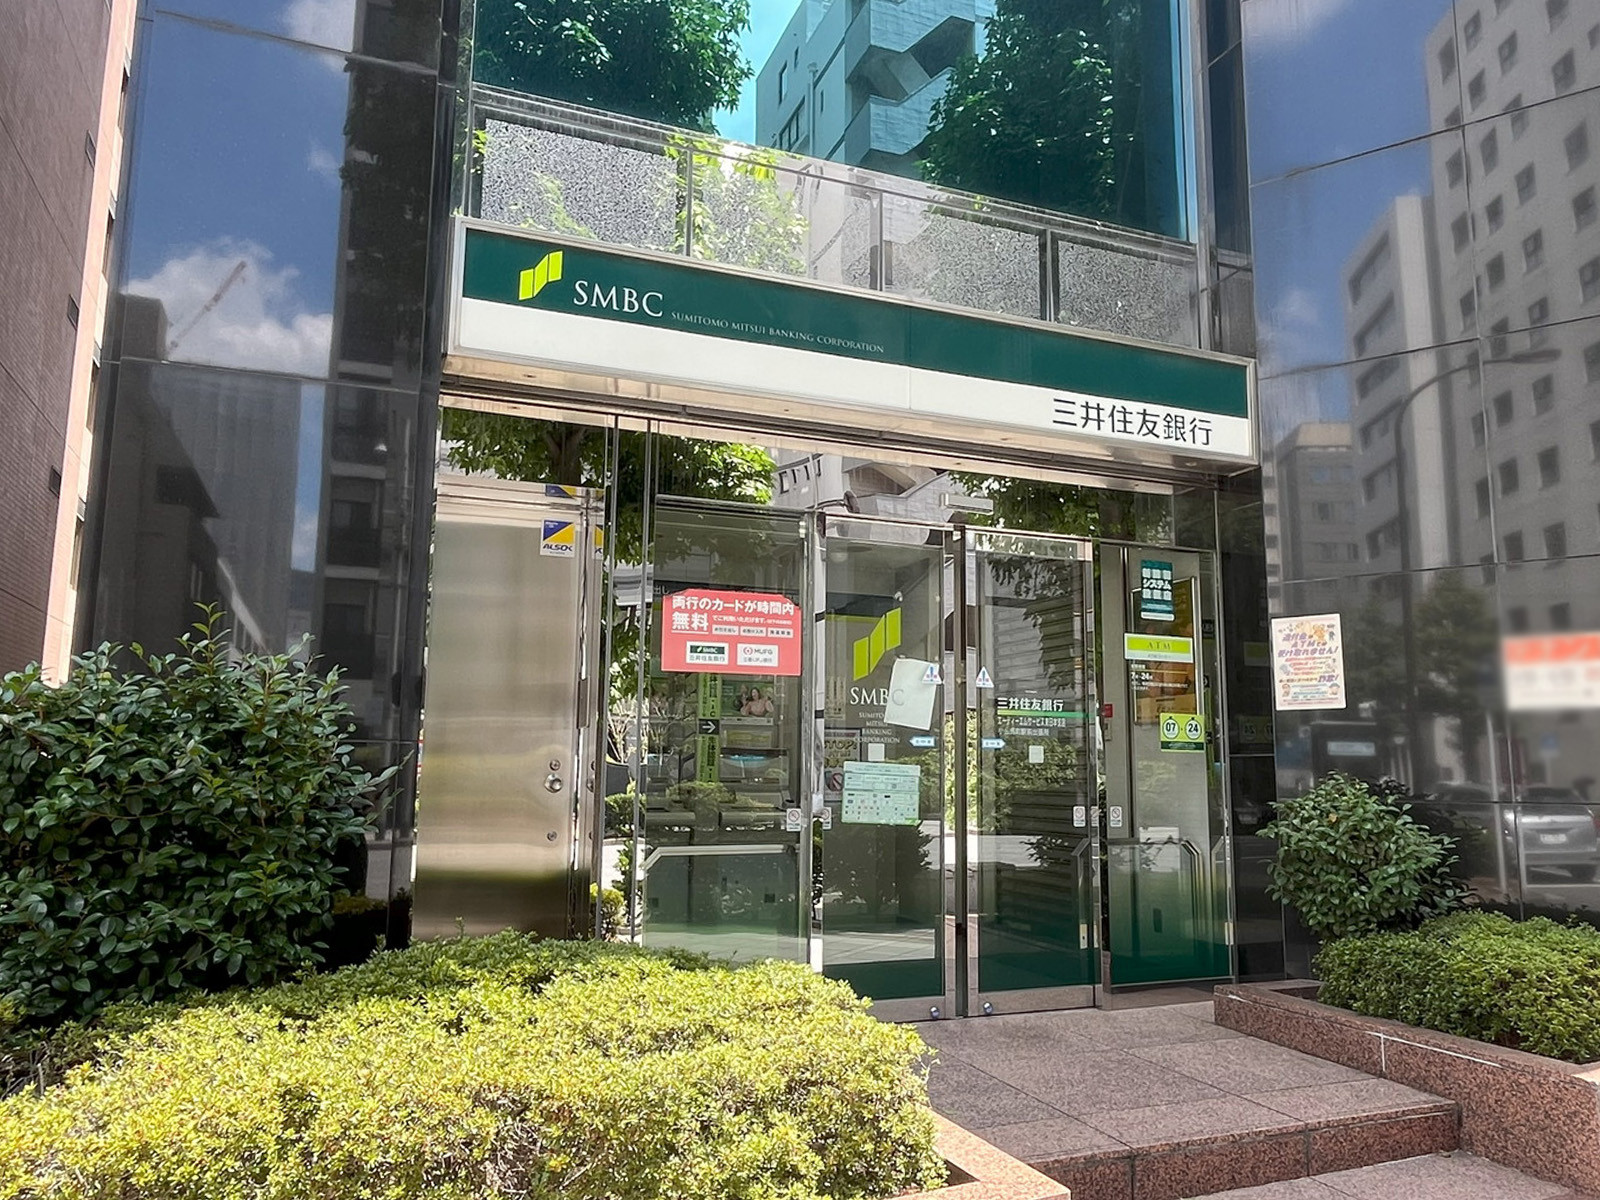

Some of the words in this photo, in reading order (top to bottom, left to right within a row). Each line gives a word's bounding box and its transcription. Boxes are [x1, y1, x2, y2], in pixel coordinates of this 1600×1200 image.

[573, 280, 663, 317] SMBC
[671, 311, 728, 328] SUMITOMO
[732, 322, 765, 334] MITSUI
[769, 327, 814, 342] BANKING
[816, 334, 884, 352] CORPORATION
[1053, 398, 1212, 446] 三井住友銀行
[543, 543, 573, 552] ALSOK
[672, 595, 795, 616] 両行のカードが時間内
[672, 611, 709, 631] 無料
[1148, 641, 1171, 650] ATM
[850, 686, 904, 706] SMBC
[997, 697, 1064, 712] 三井住友銀行
[1166, 722, 1176, 732] 07
[1188, 724, 1198, 734] 24
